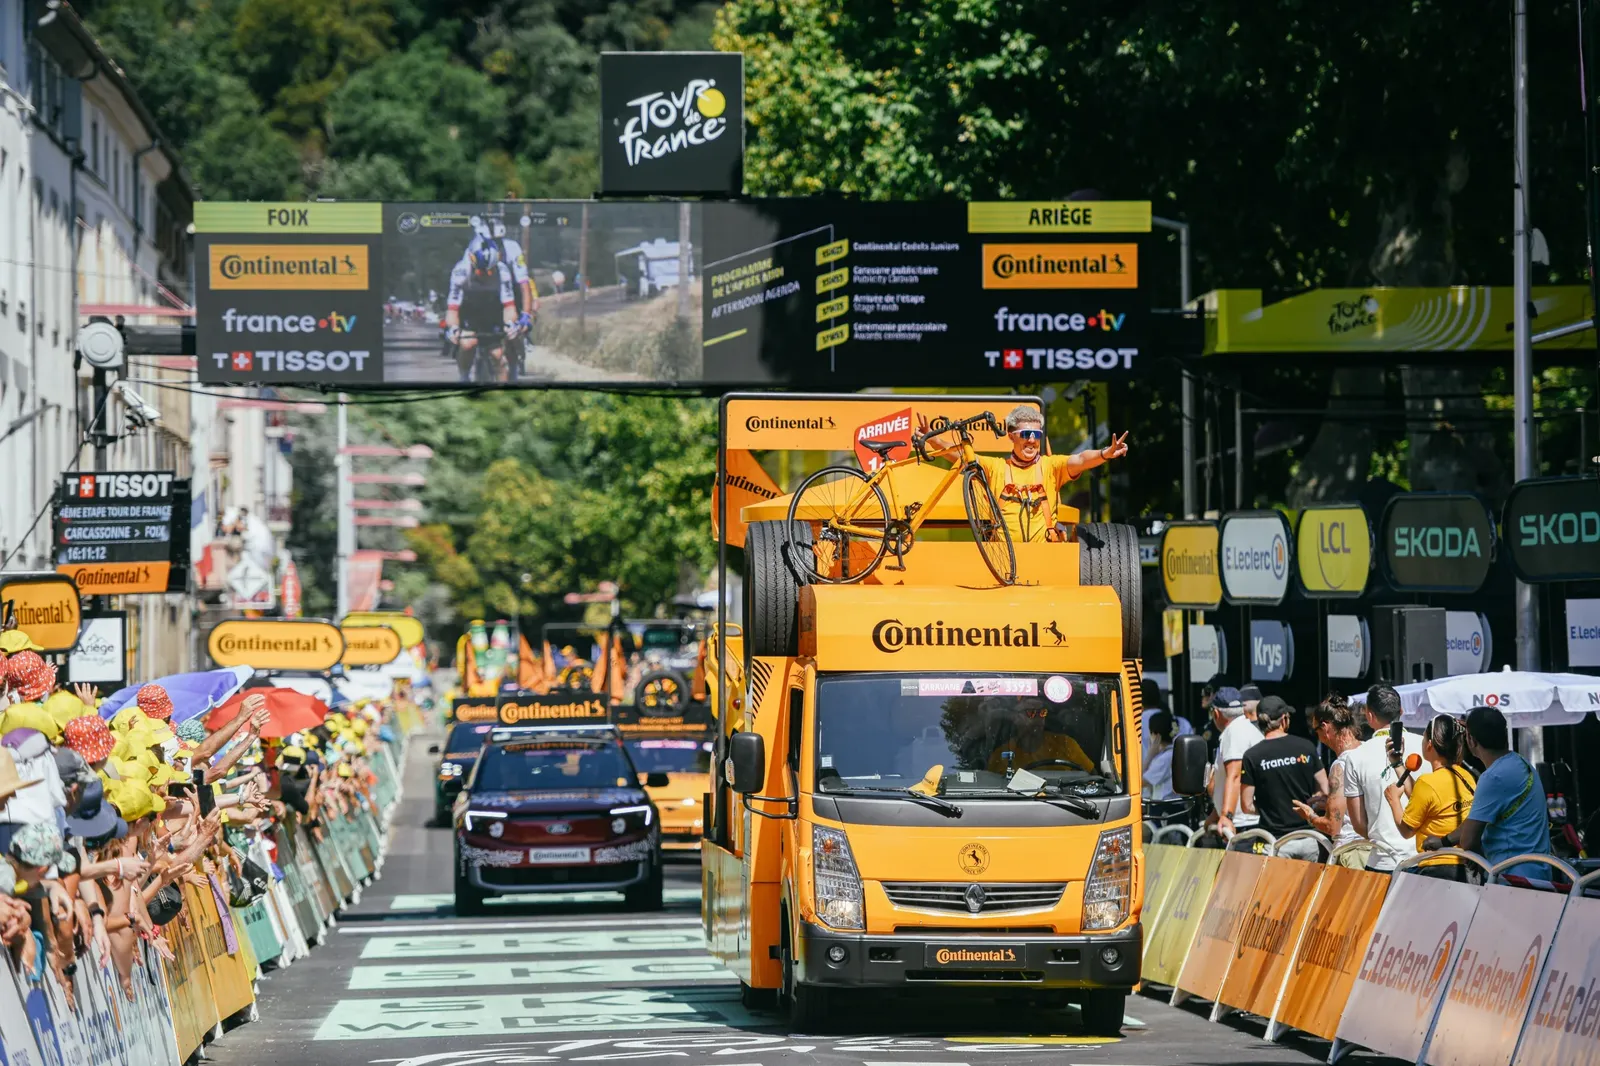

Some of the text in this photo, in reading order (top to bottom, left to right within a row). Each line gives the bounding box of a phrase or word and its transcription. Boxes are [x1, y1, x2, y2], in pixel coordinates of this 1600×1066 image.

[267, 209, 309, 226] FOIX
[1029, 204, 1092, 225] ARIÈGE
[220, 255, 337, 279] Continental
[992, 254, 1107, 279] Continental
[255, 351, 370, 371] TISSOT
[1026, 348, 1138, 369] TISSOT
[745, 415, 823, 433] Continental
[857, 416, 910, 441] ARRIVÉE
[96, 474, 172, 498] TISSOT
[107, 505, 129, 518] TOUR
[142, 505, 172, 517] FRANCE
[64, 526, 131, 540] CARCASSONNE
[1320, 522, 1351, 554] LCL
[1395, 527, 1482, 558] SKODA
[1167, 548, 1213, 581] Continental
[1226, 547, 1270, 571] E.Leclerc
[75, 567, 140, 590] Continental
[218, 633, 317, 655] Continental
[872, 618, 1041, 653] Continental
[1446, 638, 1470, 651] eclerc
[73, 643, 115, 656] Ariège
[1254, 637, 1282, 673] Krys
[921, 683, 960, 692] CARAVANE
[1472, 693, 1511, 707] NOS
[500, 701, 591, 724] Continental
[936, 948, 1005, 964] Continental
[1358, 932, 1429, 995] E.Leclerc
[1450, 948, 1516, 1014] E.Leclerc
[338, 1020, 480, 1033] We
